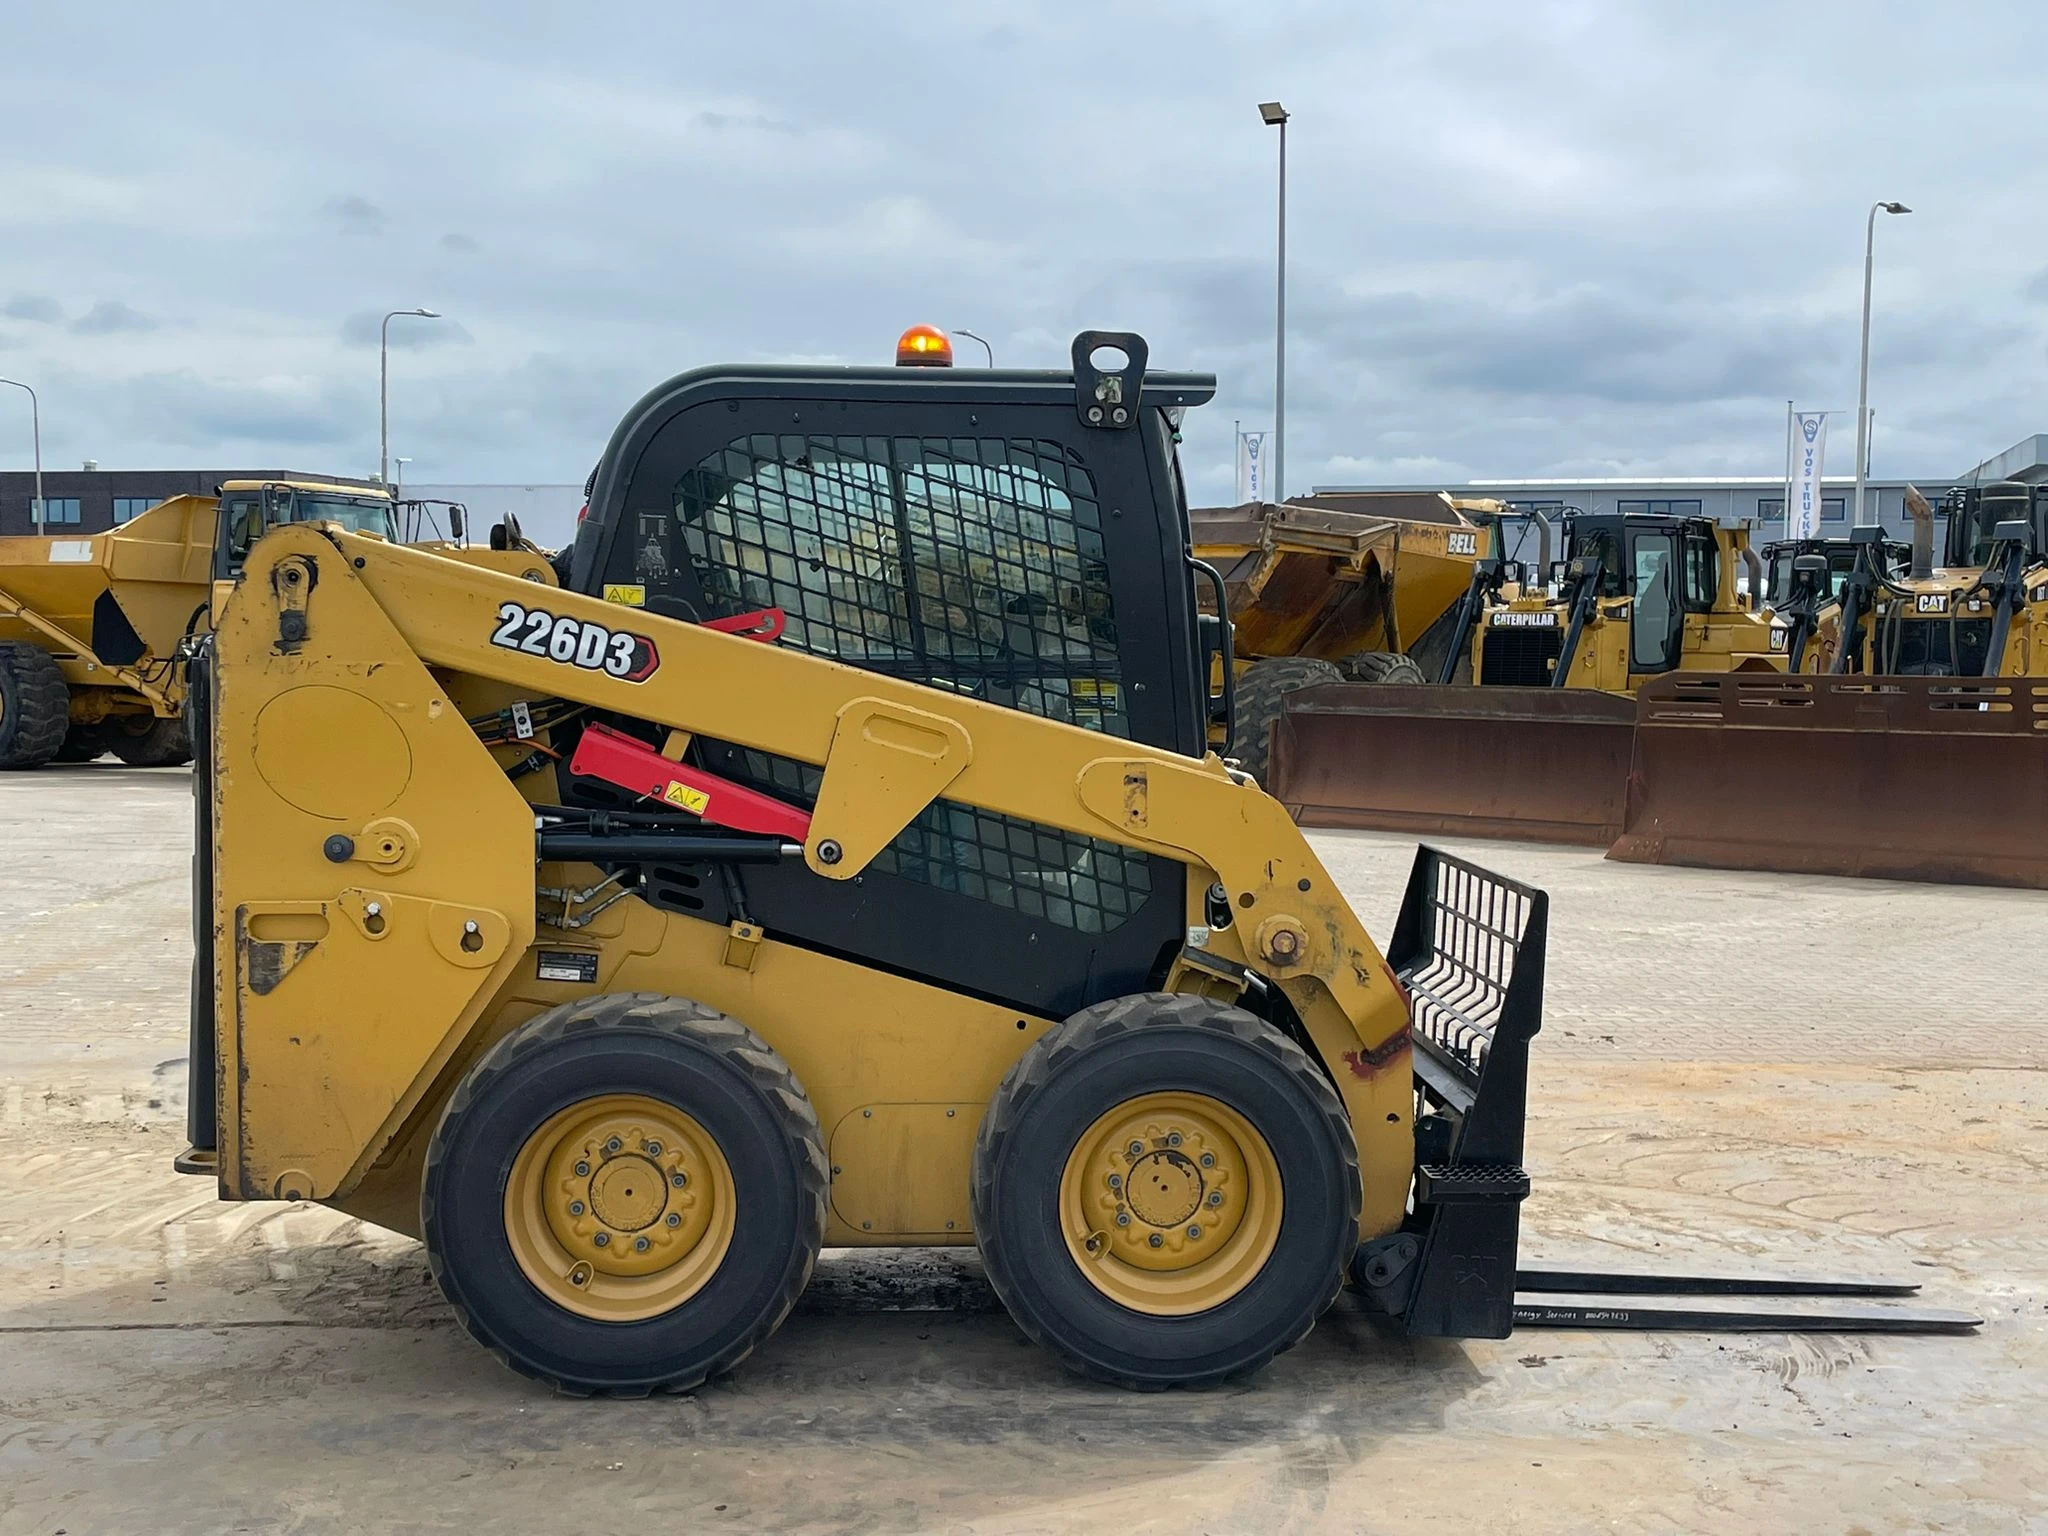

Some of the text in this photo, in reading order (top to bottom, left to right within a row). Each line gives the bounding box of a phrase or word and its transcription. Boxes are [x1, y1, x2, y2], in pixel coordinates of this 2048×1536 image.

[1802, 449, 1813, 539] VOS TRUCKS
[1447, 533, 1476, 554] BELL
[1919, 595, 1947, 612] CAT
[1493, 613, 1554, 626] CATERPILLAR
[493, 603, 636, 676] 226D3
[1771, 630, 1784, 649] CAT
[1512, 1311, 1541, 1320] ynergy
